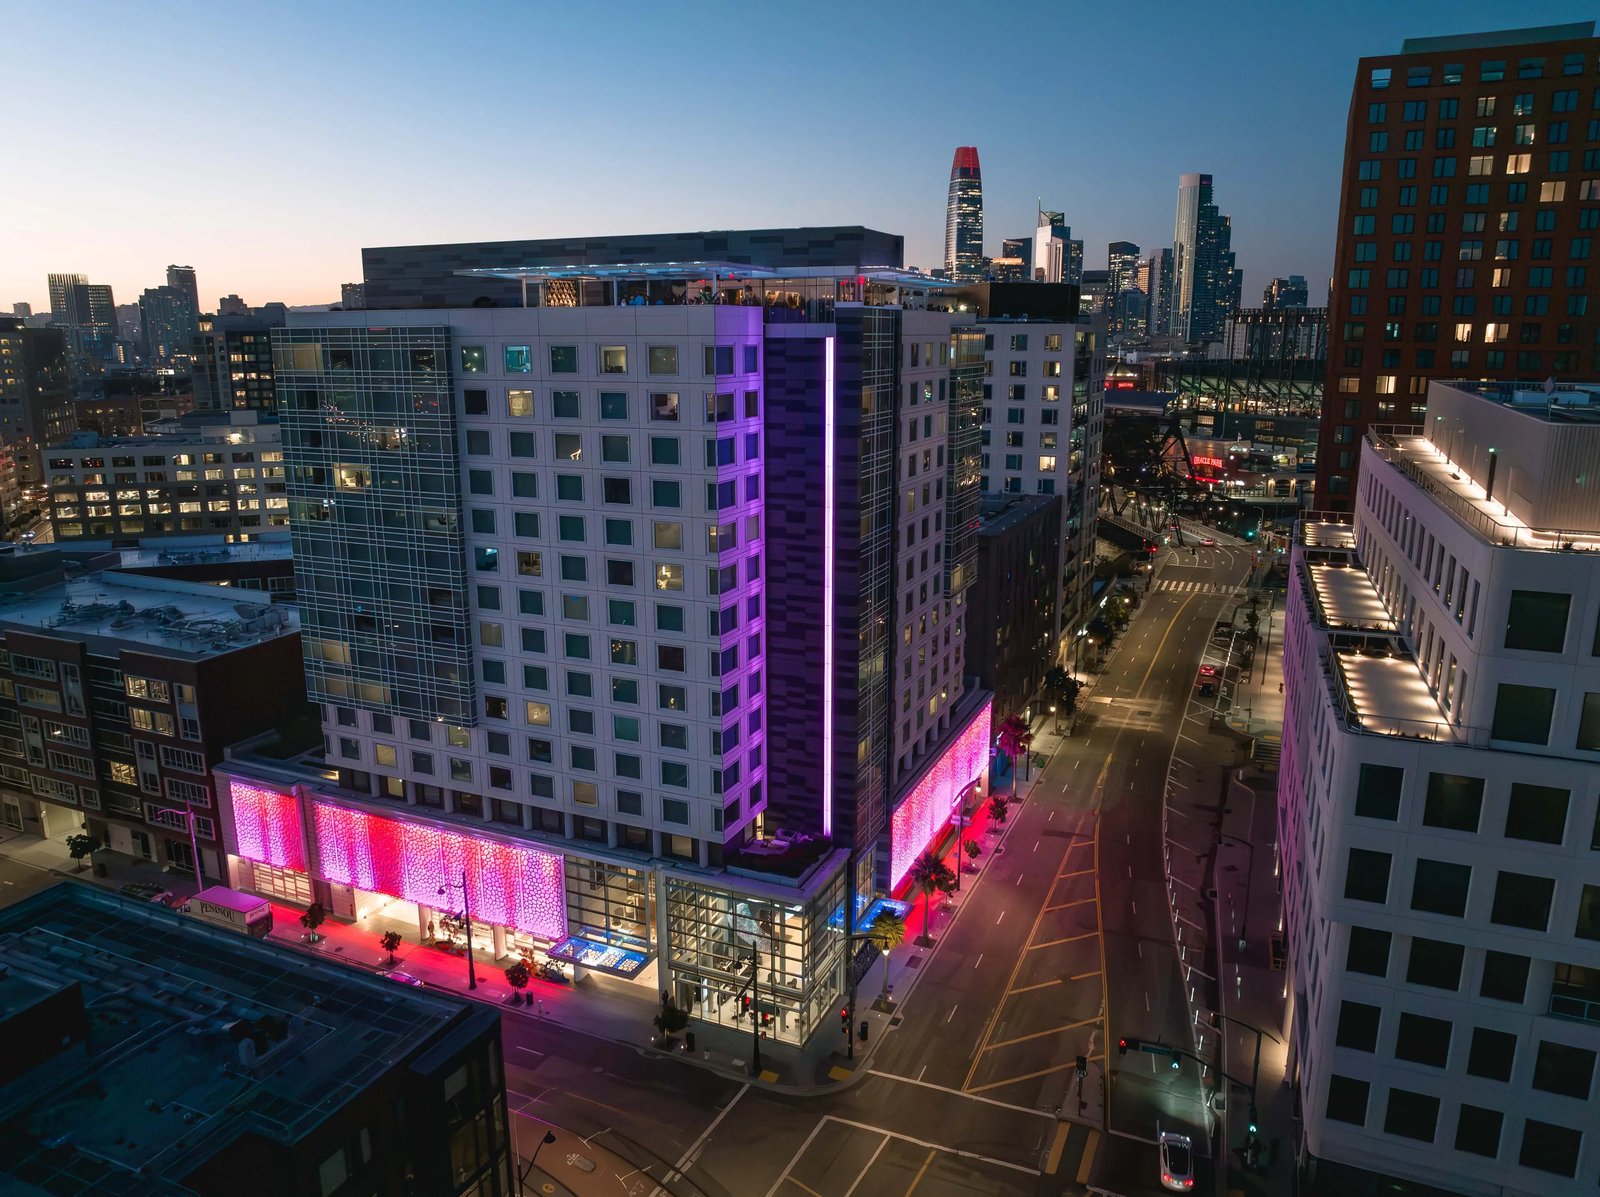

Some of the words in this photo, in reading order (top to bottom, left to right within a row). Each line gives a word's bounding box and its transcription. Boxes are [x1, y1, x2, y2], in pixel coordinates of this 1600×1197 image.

[1193, 456, 1210, 465] ORACLE
[1210, 458, 1223, 468] PARK
[200, 901, 235, 922] PENINOU
